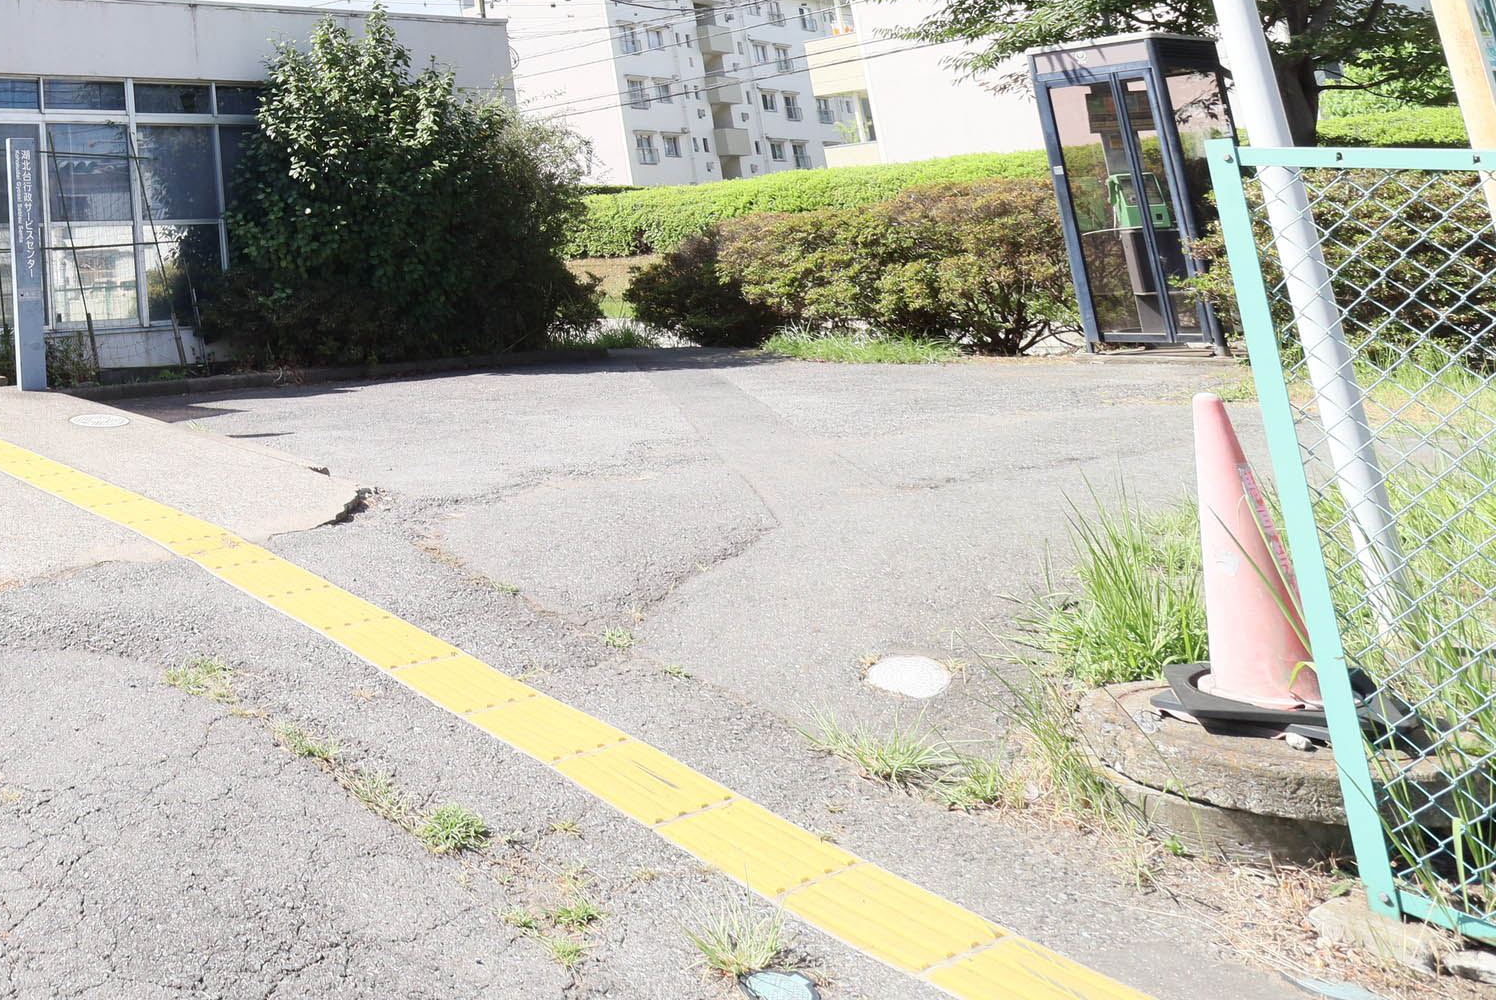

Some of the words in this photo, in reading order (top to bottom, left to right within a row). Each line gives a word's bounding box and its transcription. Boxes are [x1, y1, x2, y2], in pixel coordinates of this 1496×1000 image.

[21, 149, 35, 278] 湖北台行政サービスセンター
